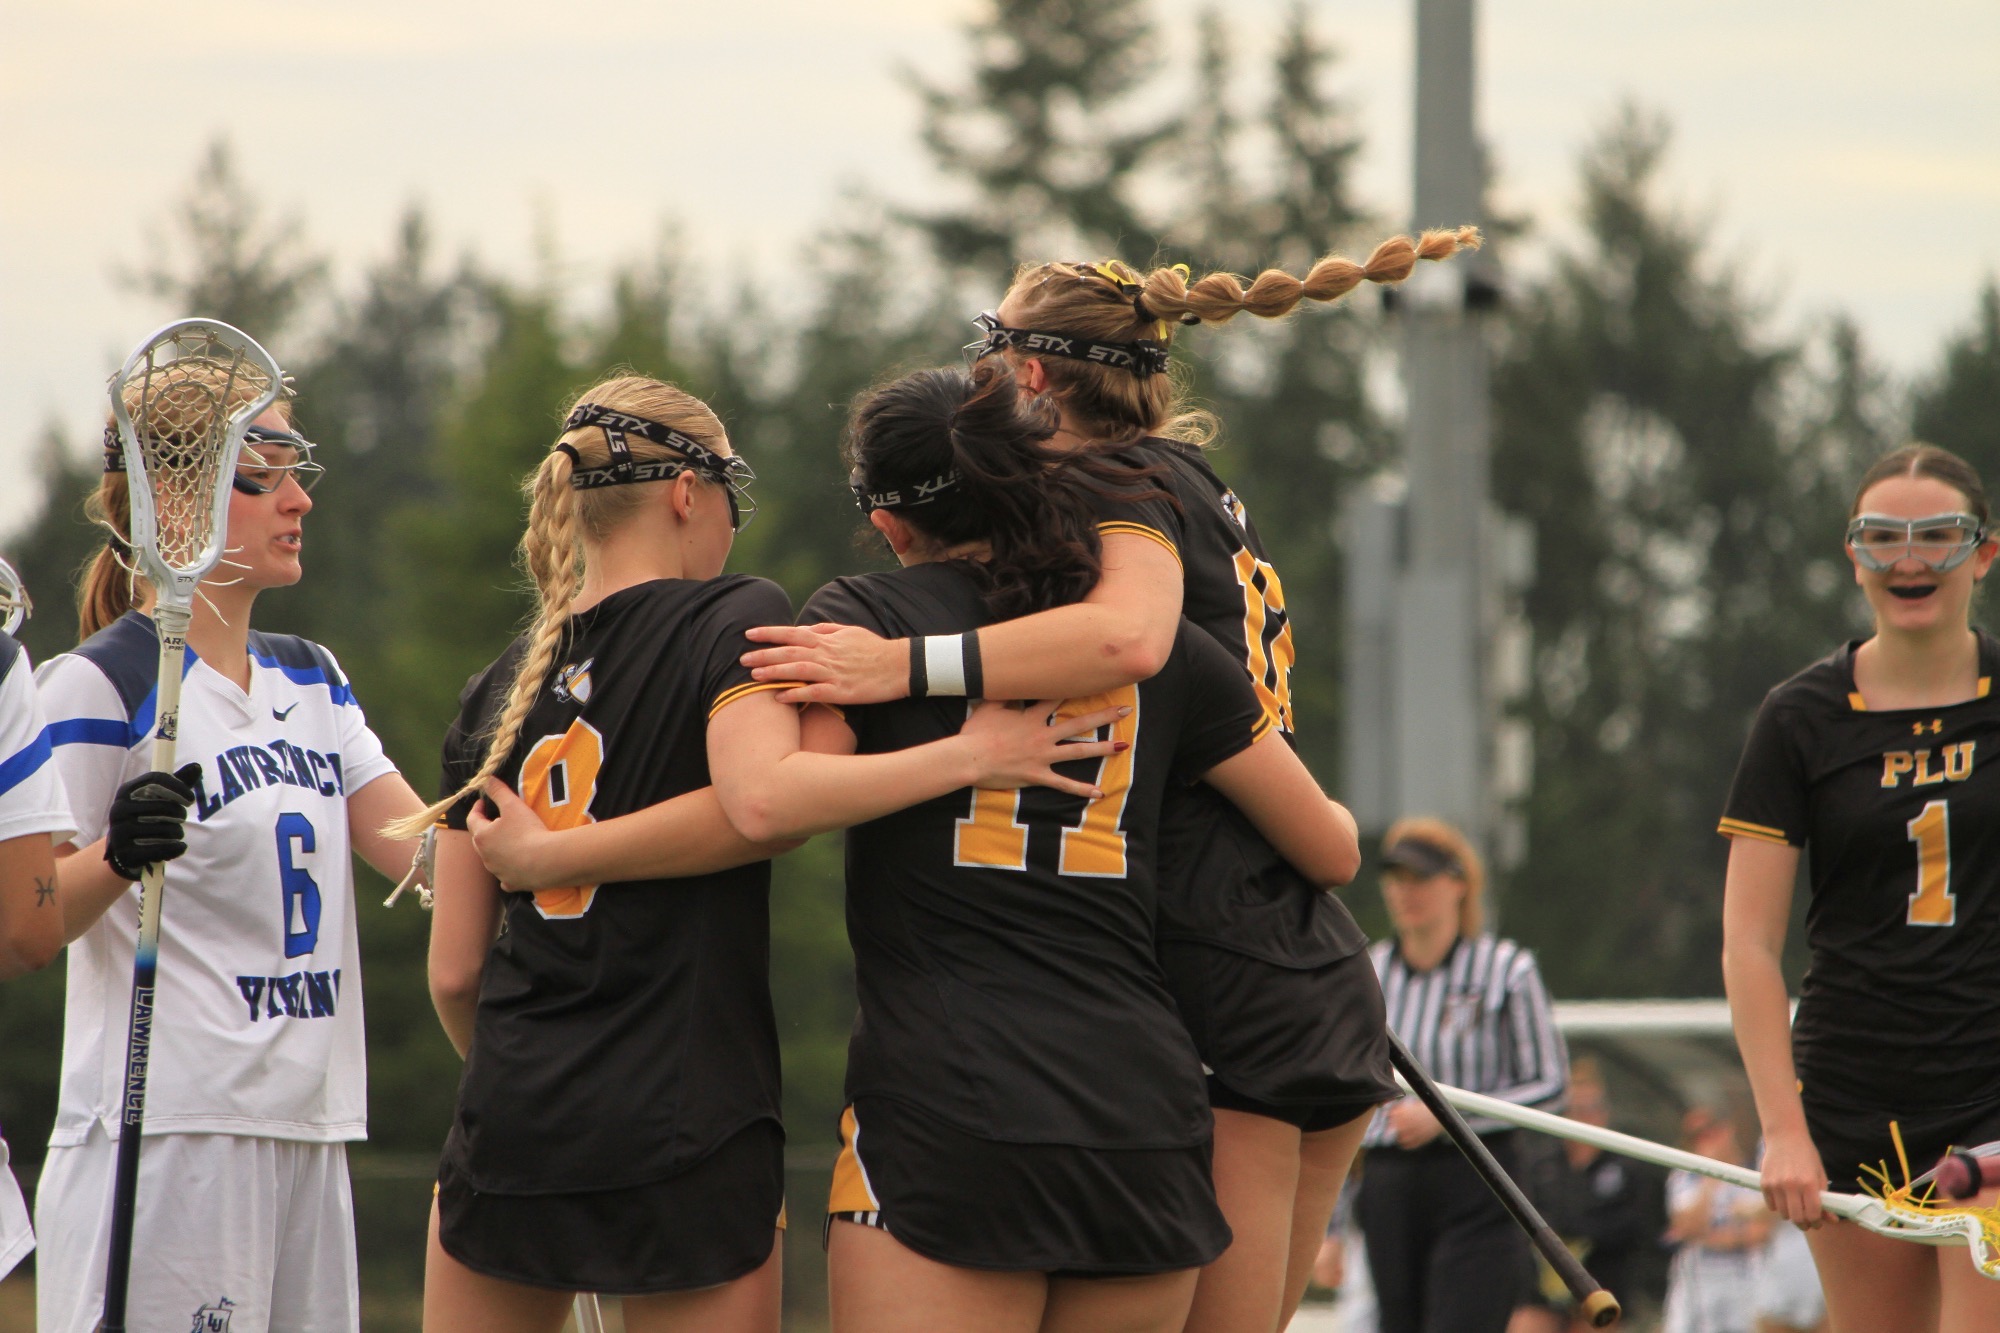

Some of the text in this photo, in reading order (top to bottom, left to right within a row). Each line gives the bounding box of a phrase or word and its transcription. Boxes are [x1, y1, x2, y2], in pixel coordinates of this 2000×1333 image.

[990, 330, 1015, 345] TX
[1027, 333, 1073, 354] STX
[597, 412, 652, 435] STX
[665, 431, 713, 465] STX
[606, 428, 627, 453] ST
[573, 468, 616, 487] STX
[634, 462, 686, 480] STX
[867, 490, 901, 507] STX
[1881, 740, 1976, 788] PLU
[275, 812, 322, 960] 6
[1906, 799, 1957, 927] 1
[124, 986, 155, 1126] LAWRENCE
